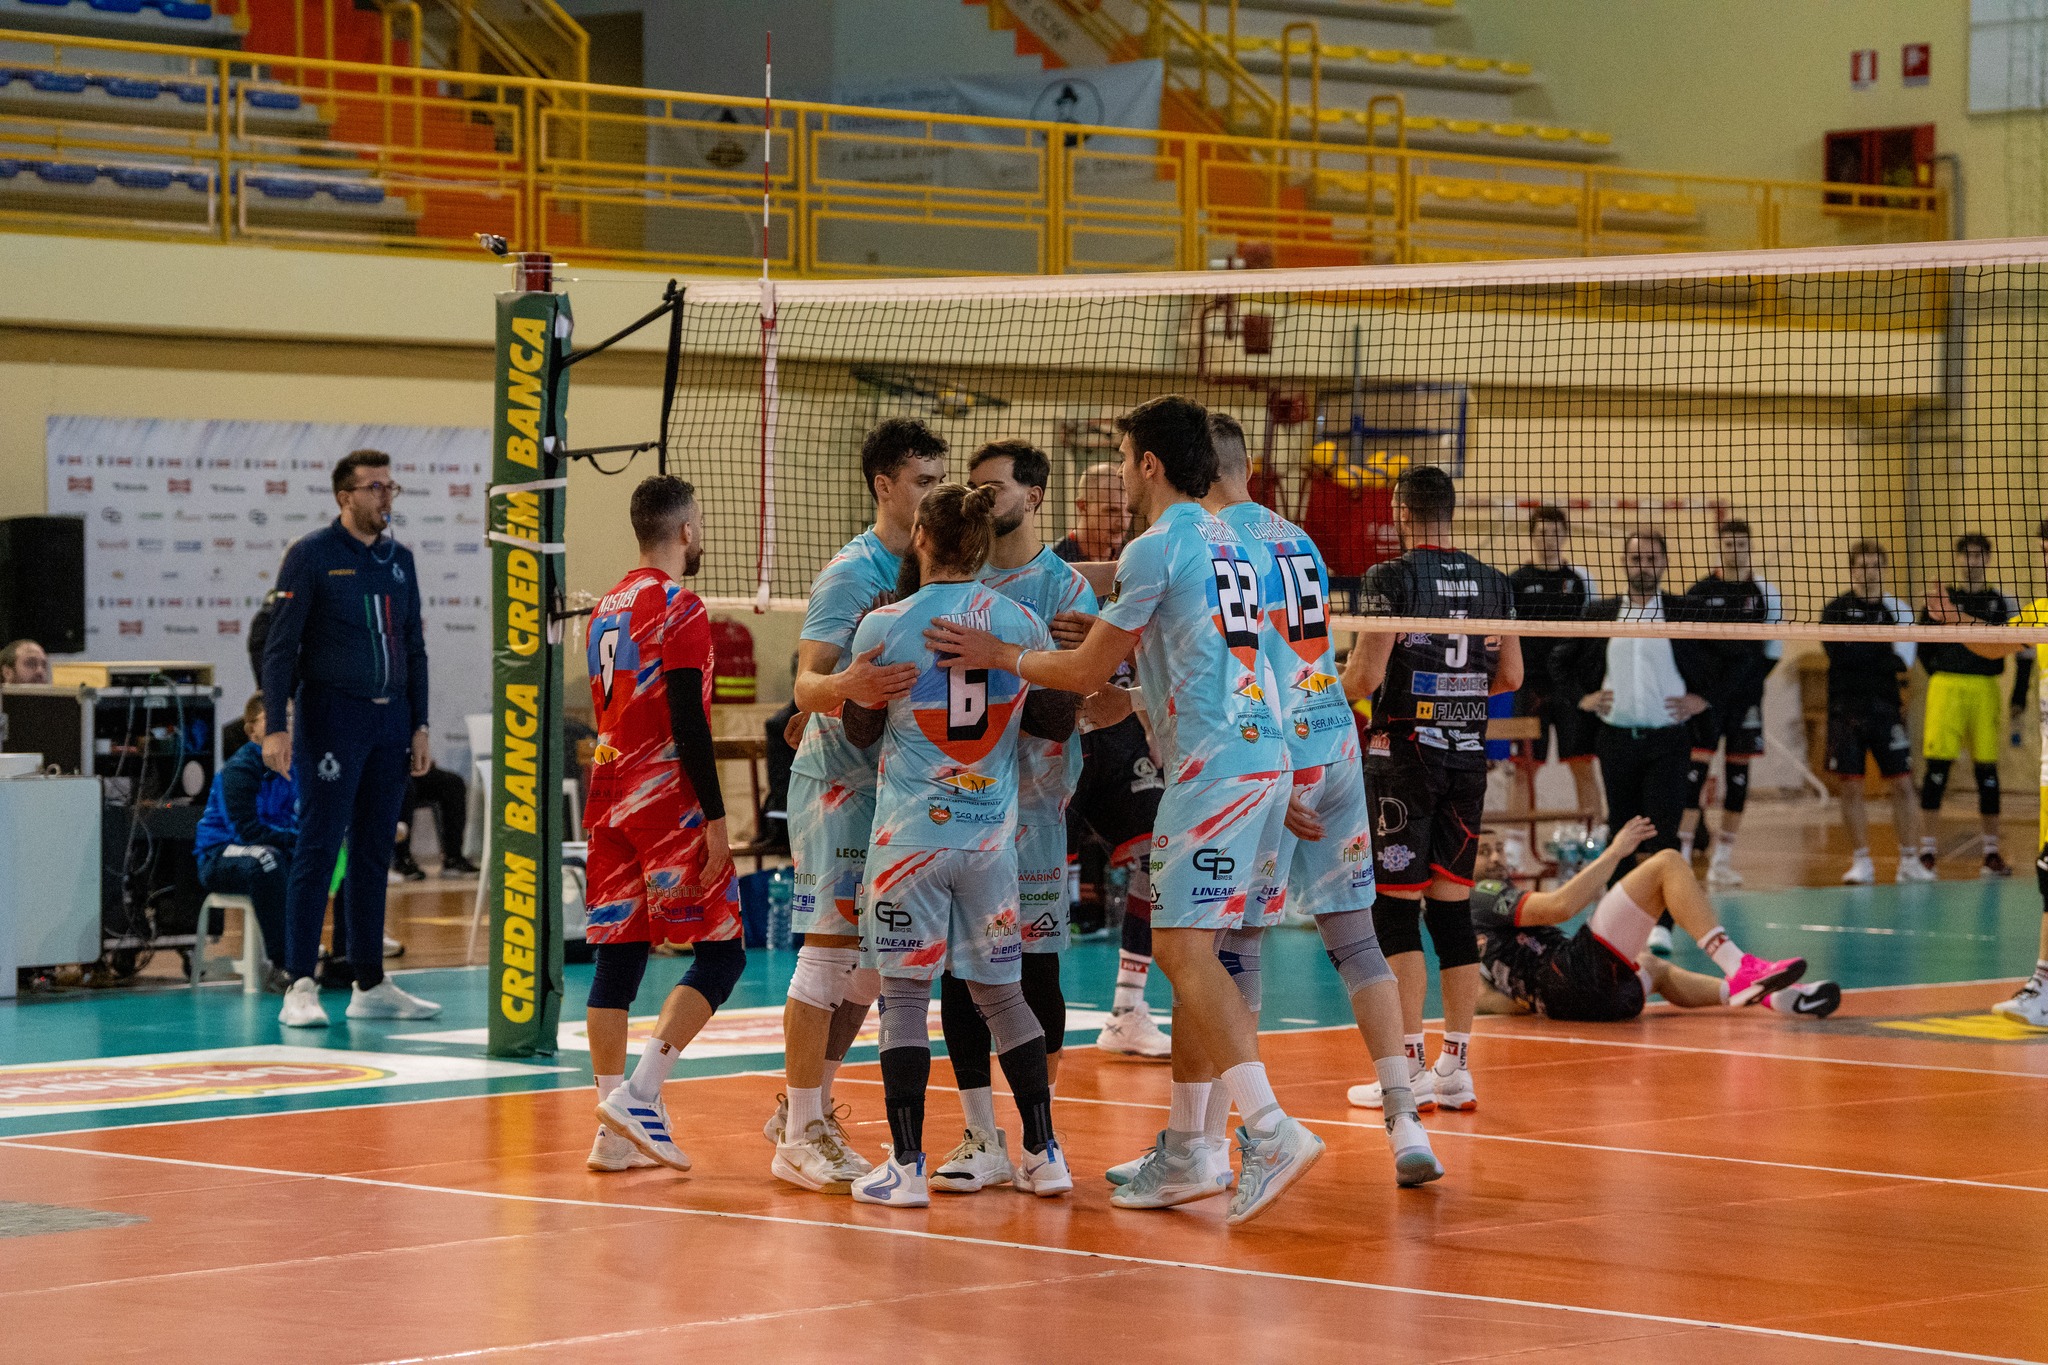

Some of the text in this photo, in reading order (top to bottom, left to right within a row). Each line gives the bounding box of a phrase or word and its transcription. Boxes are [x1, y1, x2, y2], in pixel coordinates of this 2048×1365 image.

[506, 317, 547, 656] CREDEM BANCA
[598, 589, 640, 614] NASTASI
[1213, 558, 1260, 650] 22
[1275, 553, 1328, 643] 15
[598, 627, 621, 706] 9
[947, 665, 989, 741] 6
[501, 683, 539, 1024] CREDEM BANCA
[1191, 886, 1237, 896] LINEARE
[1019, 891, 1060, 902] ecodep
[876, 936, 925, 948] LINEARE
